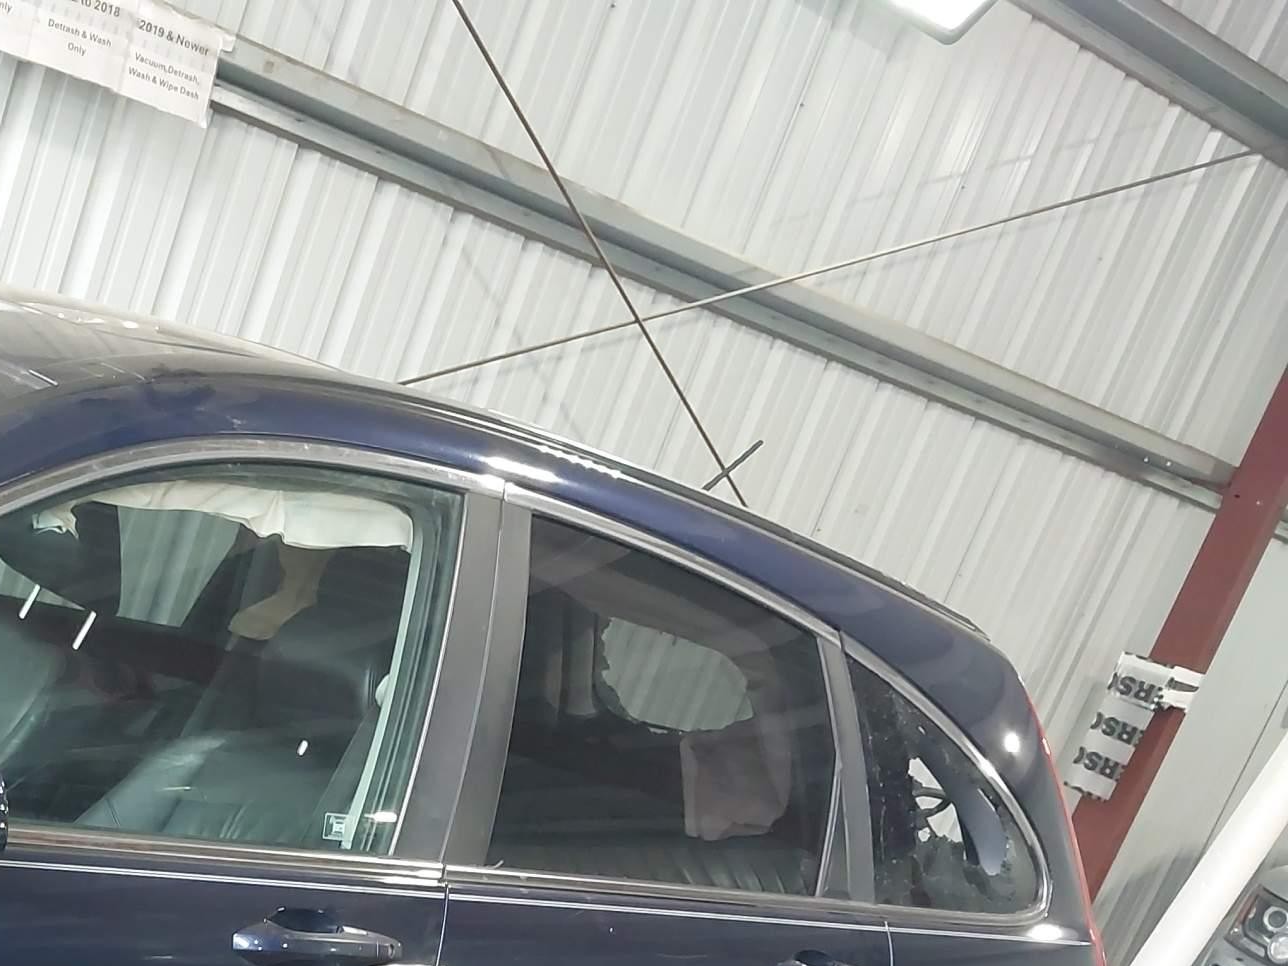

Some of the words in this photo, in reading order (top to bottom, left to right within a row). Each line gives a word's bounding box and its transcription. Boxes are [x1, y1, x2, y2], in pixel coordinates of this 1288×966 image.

[93, 0, 121, 17] 2018
[48, 18, 80, 37] Detrash
[81, 31, 88, 39] &
[89, 32, 112, 47] Wash
[138, 19, 165, 38] 2019
[166, 30, 175, 41] &
[67, 42, 87, 57] Only
[128, 66, 151, 82] Wash
[151, 76, 158, 84] &
[159, 78, 179, 93] Wipe
[179, 86, 200, 100] Dash
